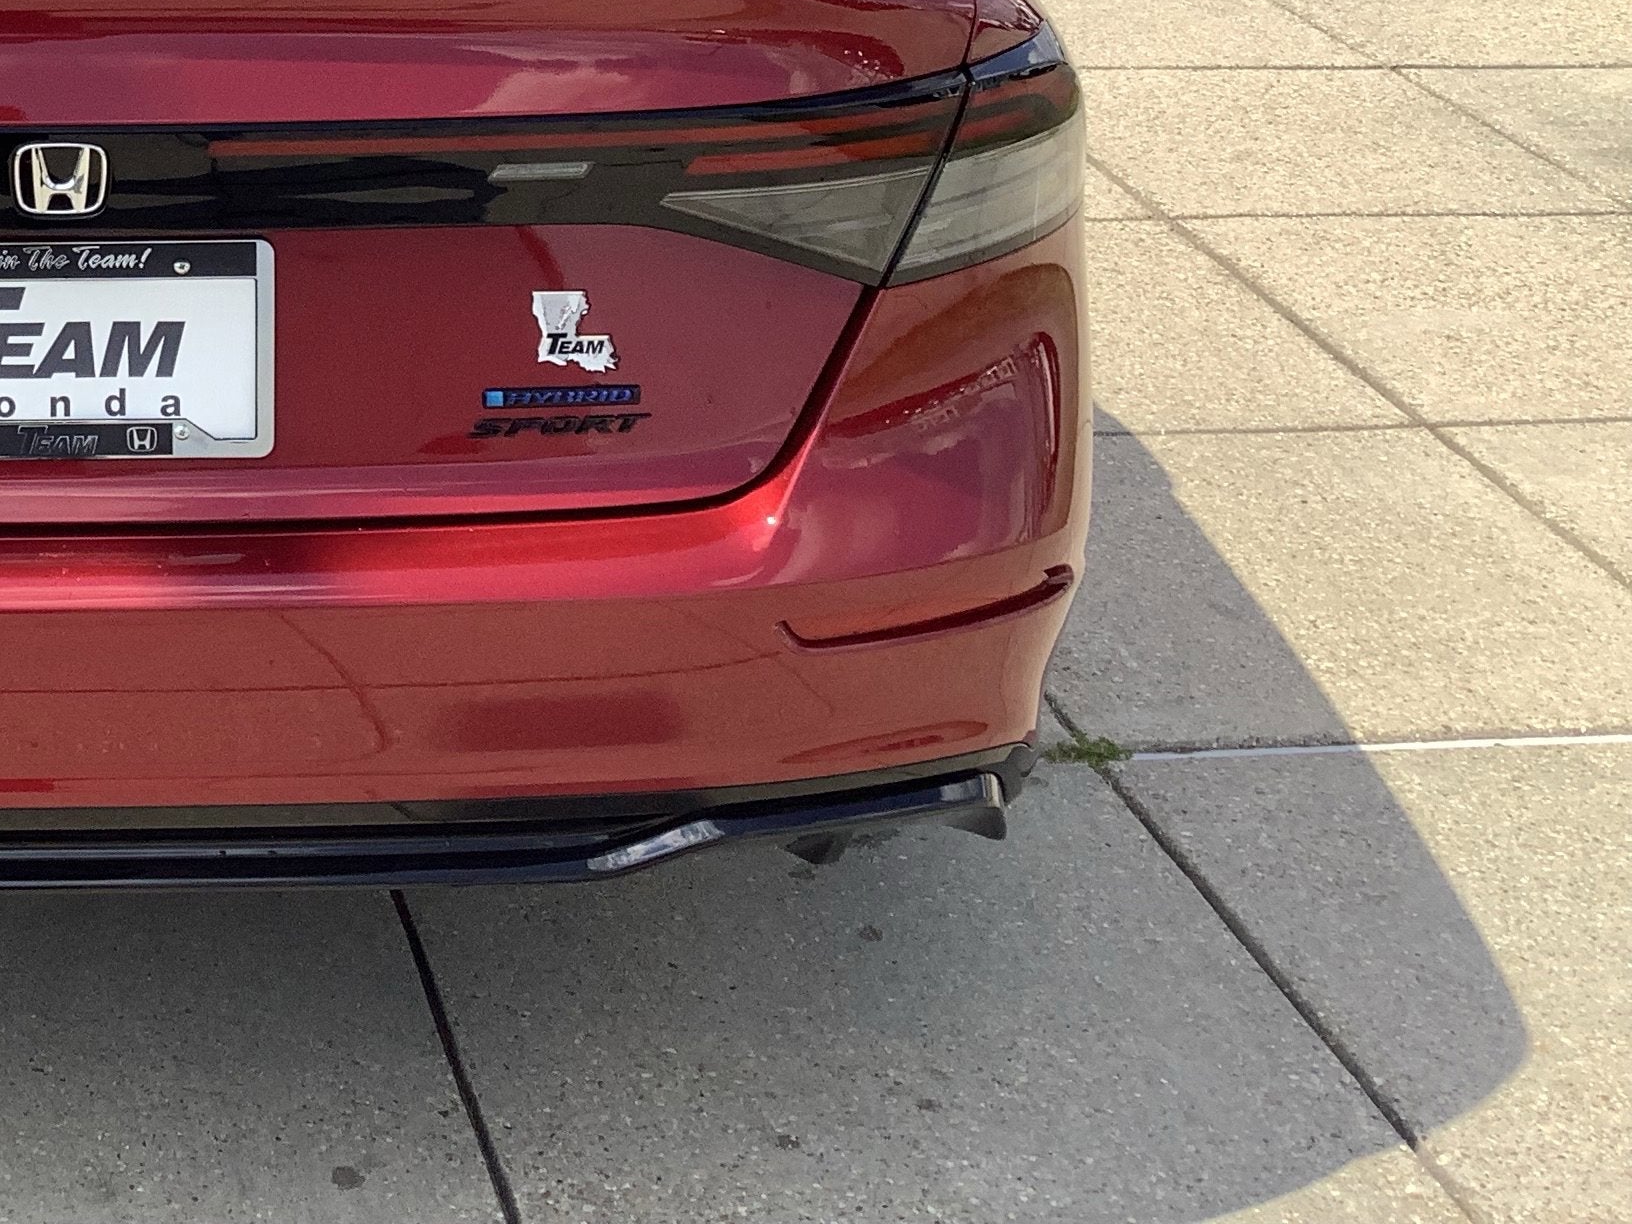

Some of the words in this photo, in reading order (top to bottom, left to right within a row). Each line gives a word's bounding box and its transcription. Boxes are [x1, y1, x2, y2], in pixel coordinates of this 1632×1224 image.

[18, 245, 70, 272] The
[71, 246, 153, 271] Team!
[546, 332, 605, 355] TEAM
[510, 389, 633, 405] HYBRID
[467, 412, 652, 439] SPORT
[17, 426, 98, 456] TEAM
